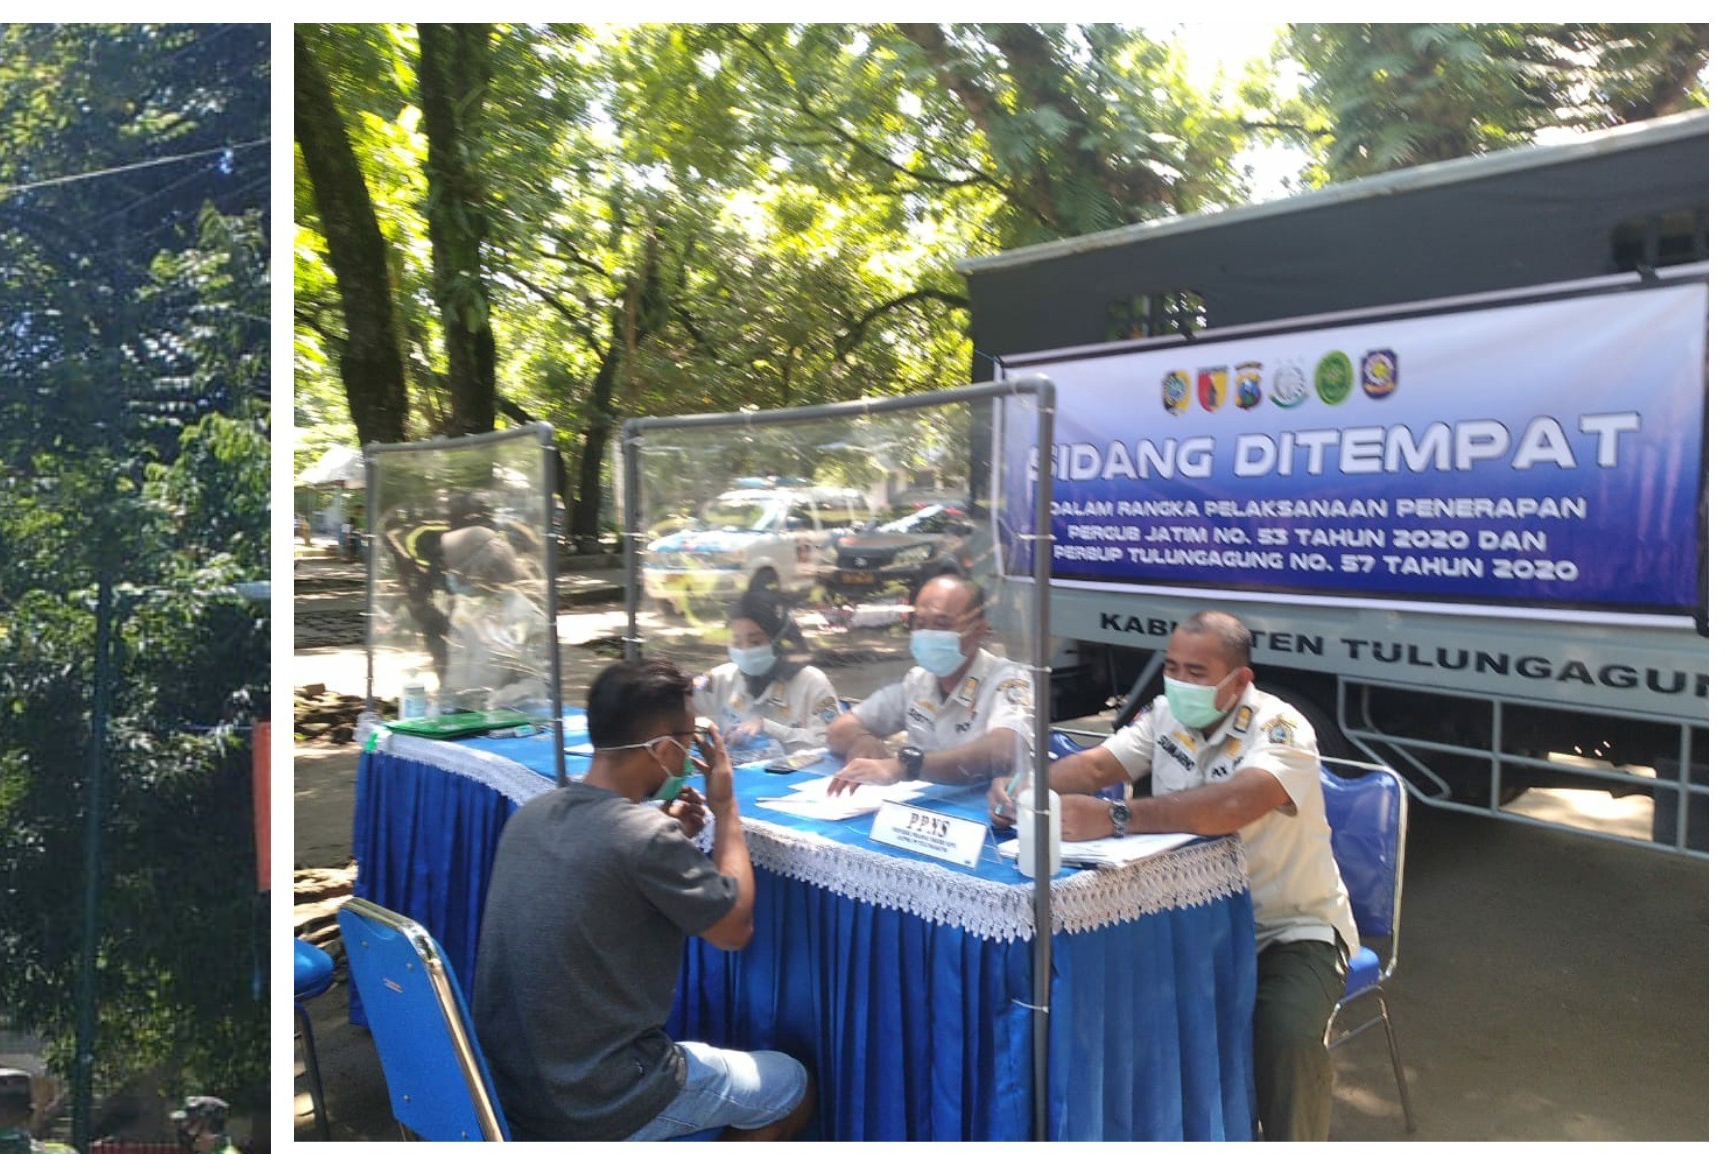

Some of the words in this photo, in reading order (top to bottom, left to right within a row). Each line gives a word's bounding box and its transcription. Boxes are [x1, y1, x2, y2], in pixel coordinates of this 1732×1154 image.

[1235, 412, 1642, 478] DITEMPAT
[1049, 501, 1113, 518] DALAM
[1117, 501, 1199, 518] RANGKA
[1205, 499, 1388, 519] PELAKSANAAN
[1396, 497, 1587, 519] PENERAPAN
[1068, 524, 1141, 542] PERGUB
[1145, 525, 1208, 544] JATIM
[1214, 527, 1251, 546] NO.
[1258, 528, 1289, 546] 53
[1294, 528, 1385, 549] TAHUN
[1392, 529, 1470, 550] 2020
[1478, 530, 1547, 552] DAN
[1054, 544, 1123, 563] PERBUP
[1127, 548, 1284, 571] TULUNGAGUNG
[1289, 553, 1334, 572] NO.
[1340, 554, 1376, 575] 57
[1382, 554, 1484, 578] TAHUN
[1491, 557, 1579, 582] 2020
